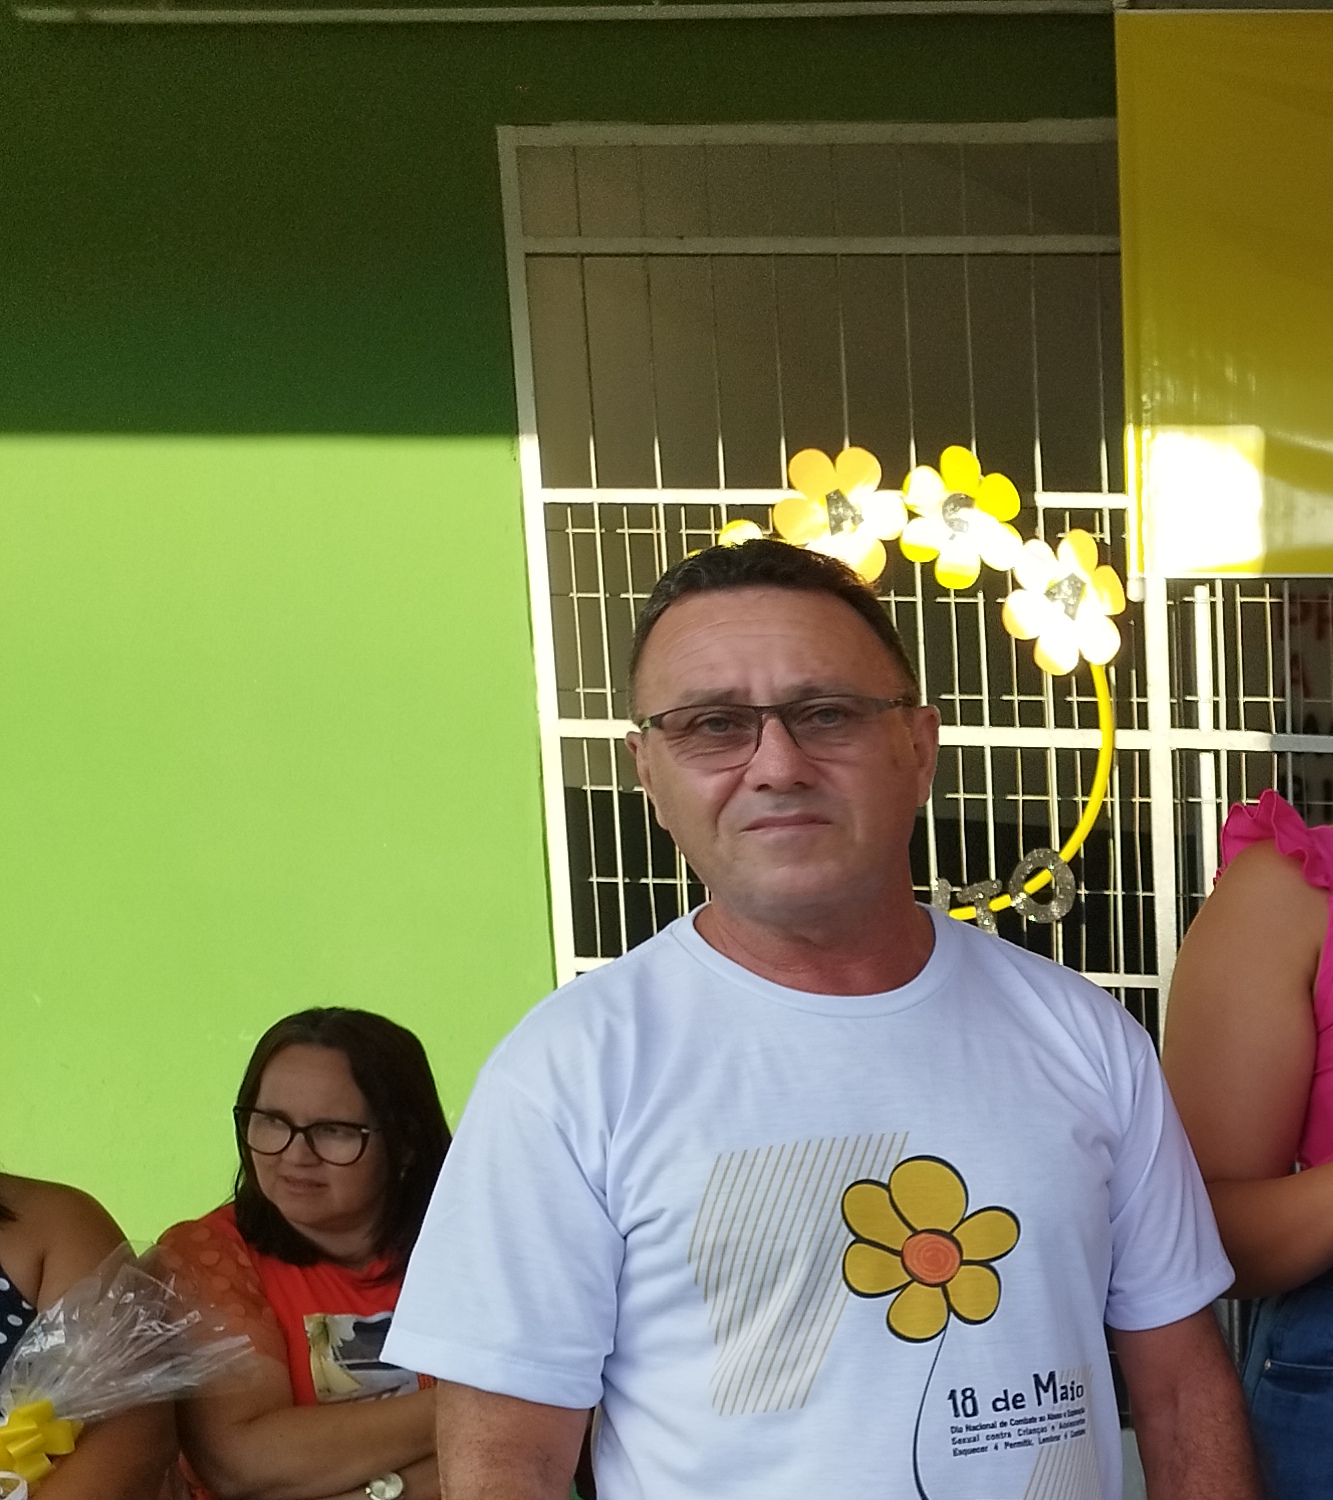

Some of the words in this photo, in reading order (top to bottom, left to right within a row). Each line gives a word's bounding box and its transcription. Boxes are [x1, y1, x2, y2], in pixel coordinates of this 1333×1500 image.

[947, 1387, 979, 1418] 18
[992, 1389, 1026, 1412] de
[1033, 1371, 1084, 1406] Maio
